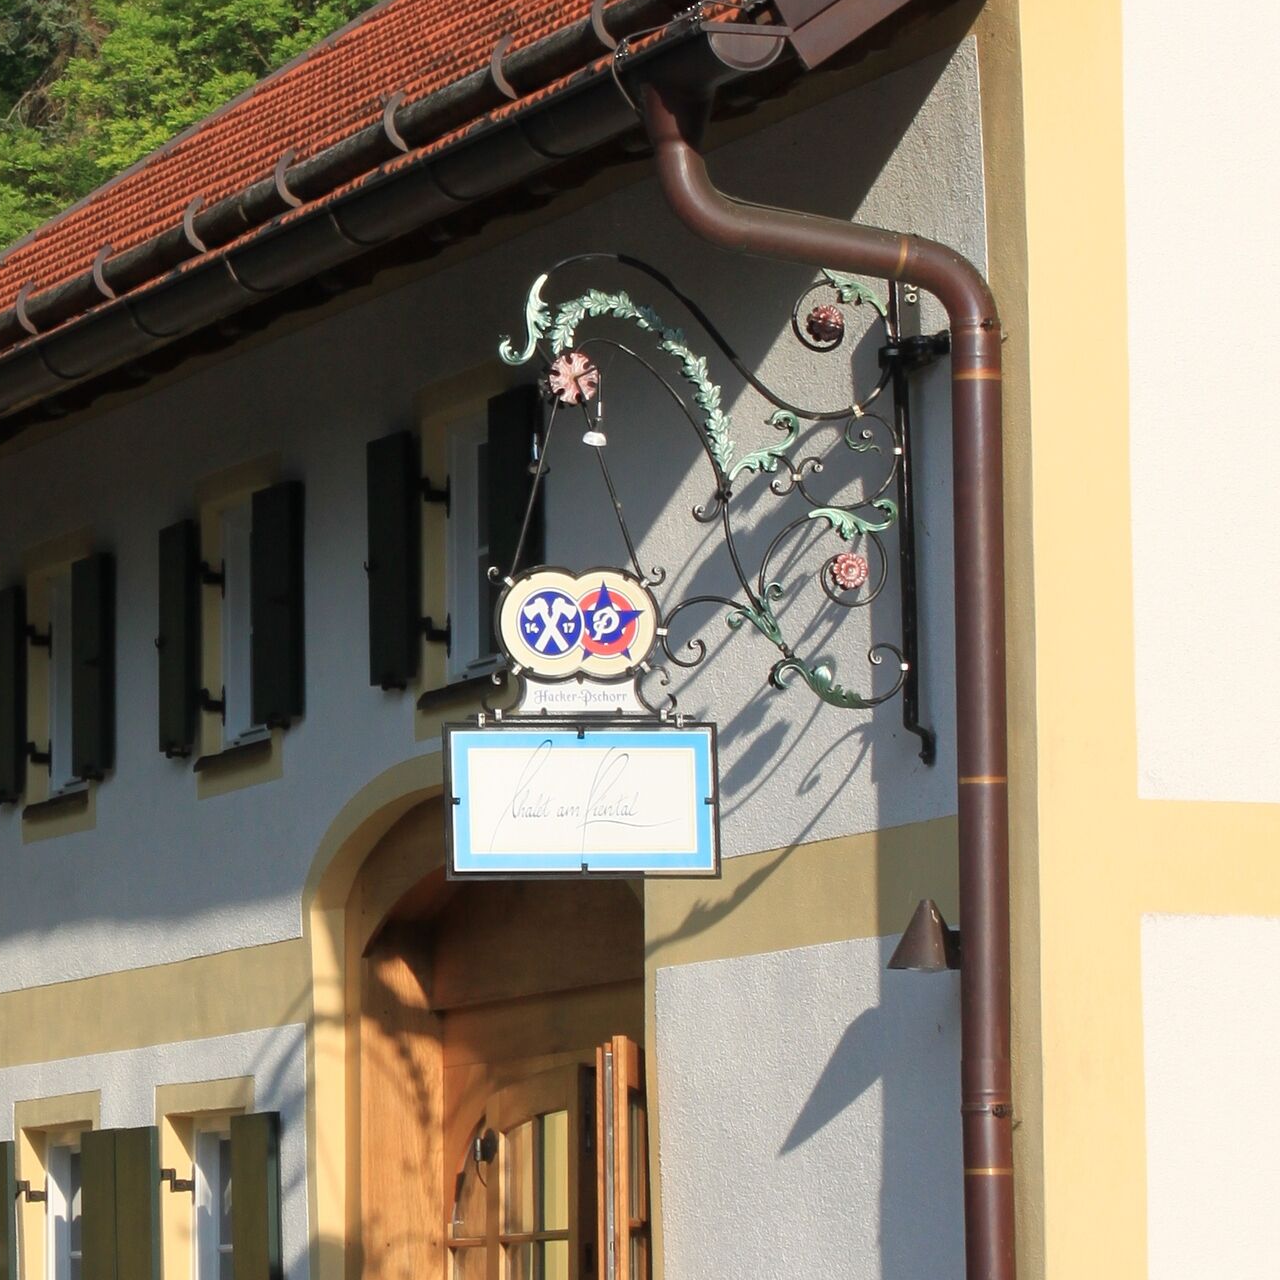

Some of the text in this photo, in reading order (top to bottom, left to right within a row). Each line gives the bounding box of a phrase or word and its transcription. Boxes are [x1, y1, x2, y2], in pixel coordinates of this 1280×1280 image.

[524, 622, 576, 635] 14 17
[533, 688, 629, 706] Hacker-Pschorr
[556, 803, 581, 819] am
